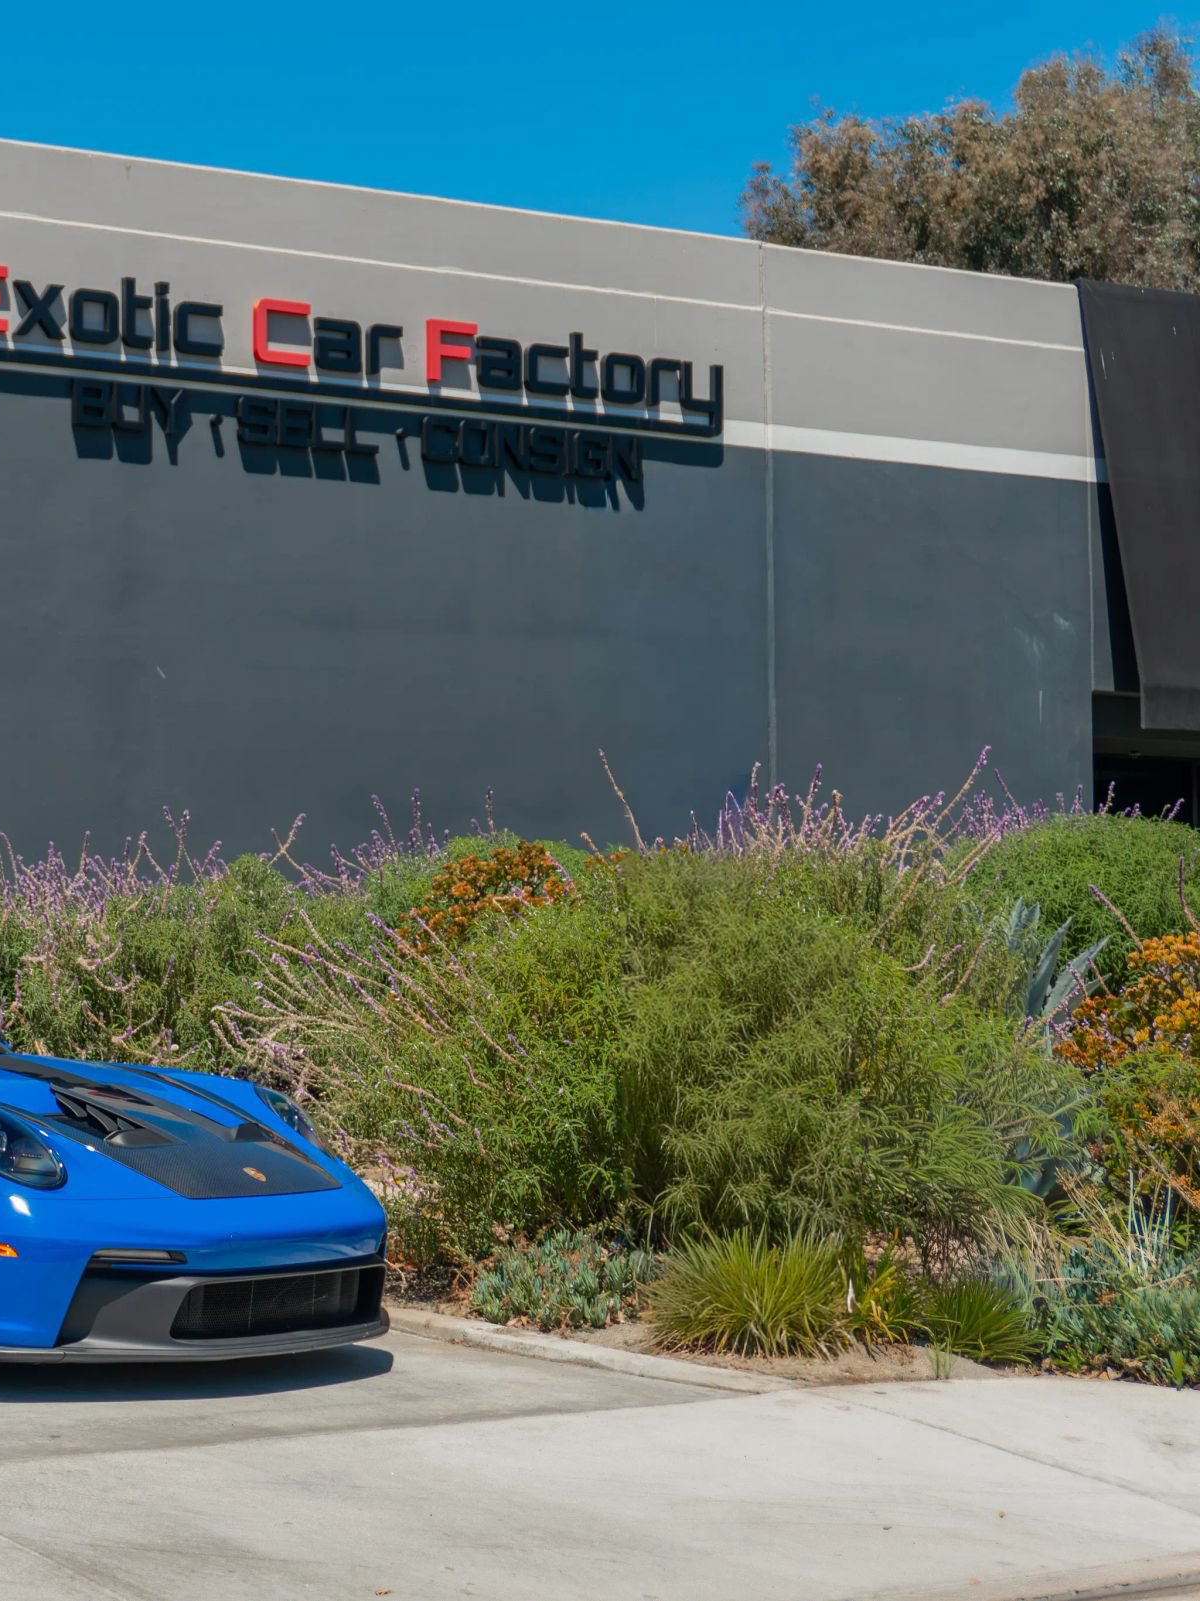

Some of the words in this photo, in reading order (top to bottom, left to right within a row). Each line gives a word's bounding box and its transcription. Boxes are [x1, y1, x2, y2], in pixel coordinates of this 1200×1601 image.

[253, 298, 403, 375] Car
[426, 318, 723, 438] Factory
[71, 378, 188, 435] BUY
[237, 397, 380, 454] SELL
[421, 415, 642, 482] CONSIGN
